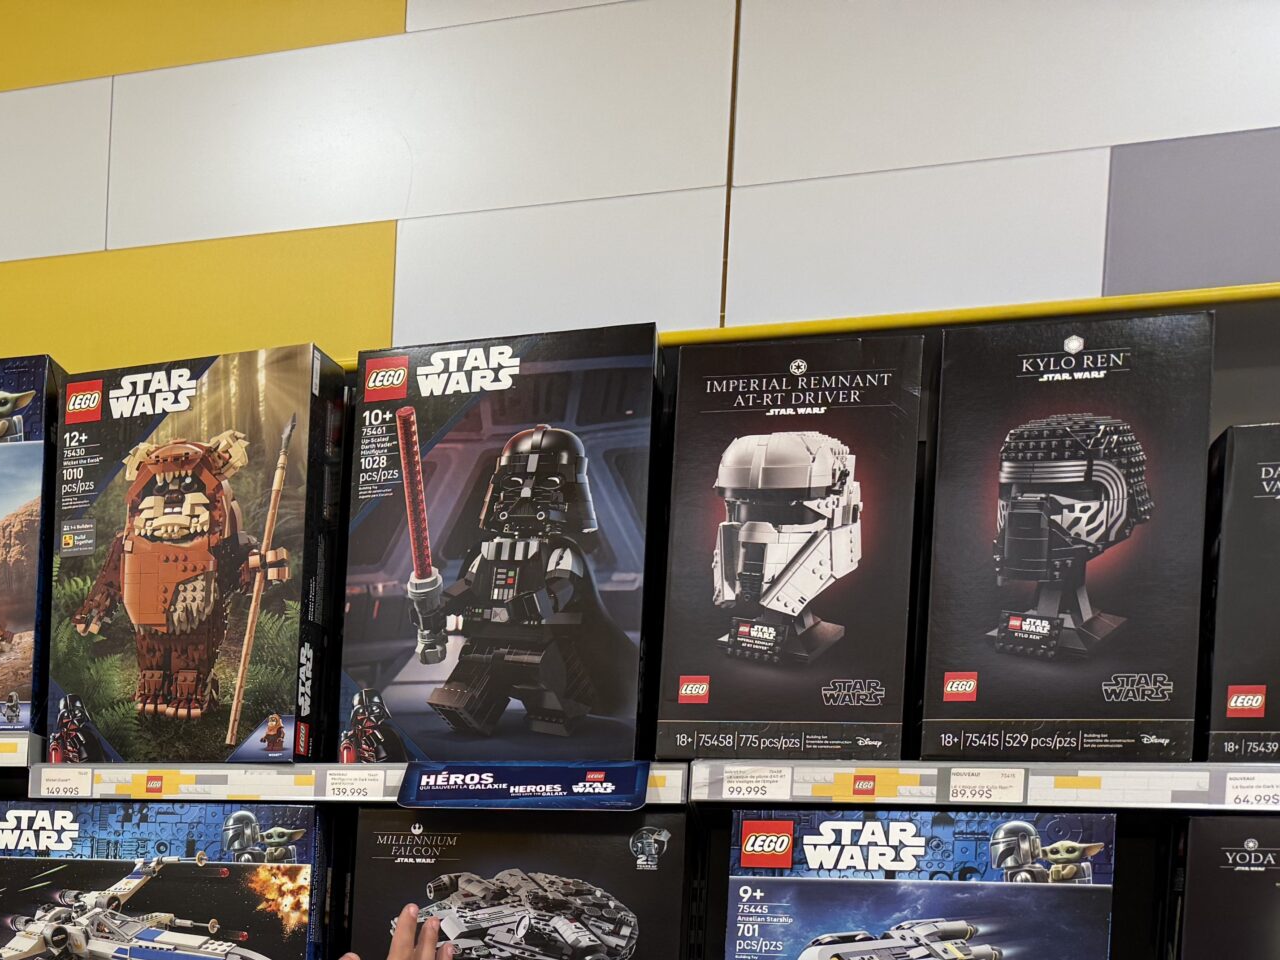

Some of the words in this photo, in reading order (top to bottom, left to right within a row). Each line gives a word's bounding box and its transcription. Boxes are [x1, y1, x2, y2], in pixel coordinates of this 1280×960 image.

[417, 346, 520, 375] STAR
[1022, 356, 1074, 373] KYLO
[1077, 352, 1123, 371] REN
[110, 368, 196, 397] STAR
[367, 368, 406, 389] LEGO
[417, 365, 520, 397] WARS
[706, 377, 794, 394] IMPERIAL
[798, 372, 892, 390] REMNANT
[68, 392, 101, 412] LEGO
[110, 389, 196, 419] WARS
[362, 409, 393, 425] 10+
[361, 426, 386, 436] 75461
[64, 432, 88, 446] 12+
[64, 448, 85, 458] 75430
[360, 457, 387, 470] 1028
[62, 468, 84, 480] 1010
[359, 469, 399, 483] pcs/pzs
[62, 481, 94, 496] pcs/pzs
[822, 680, 884, 692] STAR
[1102, 674, 1173, 688] STAR
[822, 691, 884, 706] WARS
[1102, 686, 1173, 701] WARS
[676, 734, 693, 746] 18+
[699, 734, 733, 747] 75458
[740, 735, 758, 747] 775
[761, 735, 800, 749] pcs/pzs
[940, 734, 959, 746] 18+
[965, 734, 999, 746] 75415
[1006, 734, 1029, 747] 529
[1031, 735, 1077, 749] pcs/pzs
[421, 772, 494, 786] HÉROS
[510, 784, 562, 793] HEROES
[377, 835, 457, 845] MILLENNIUM
[803, 821, 926, 846] STAR
[391, 845, 441, 855] FALCON
[743, 834, 792, 854] LEGO
[803, 845, 926, 871] WARS
[1226, 852, 1275, 864] YODA
[738, 886, 765, 902] 9+
[738, 905, 768, 913] 75445
[737, 924, 759, 936] 701
[736, 938, 783, 952] pcs/pzs
